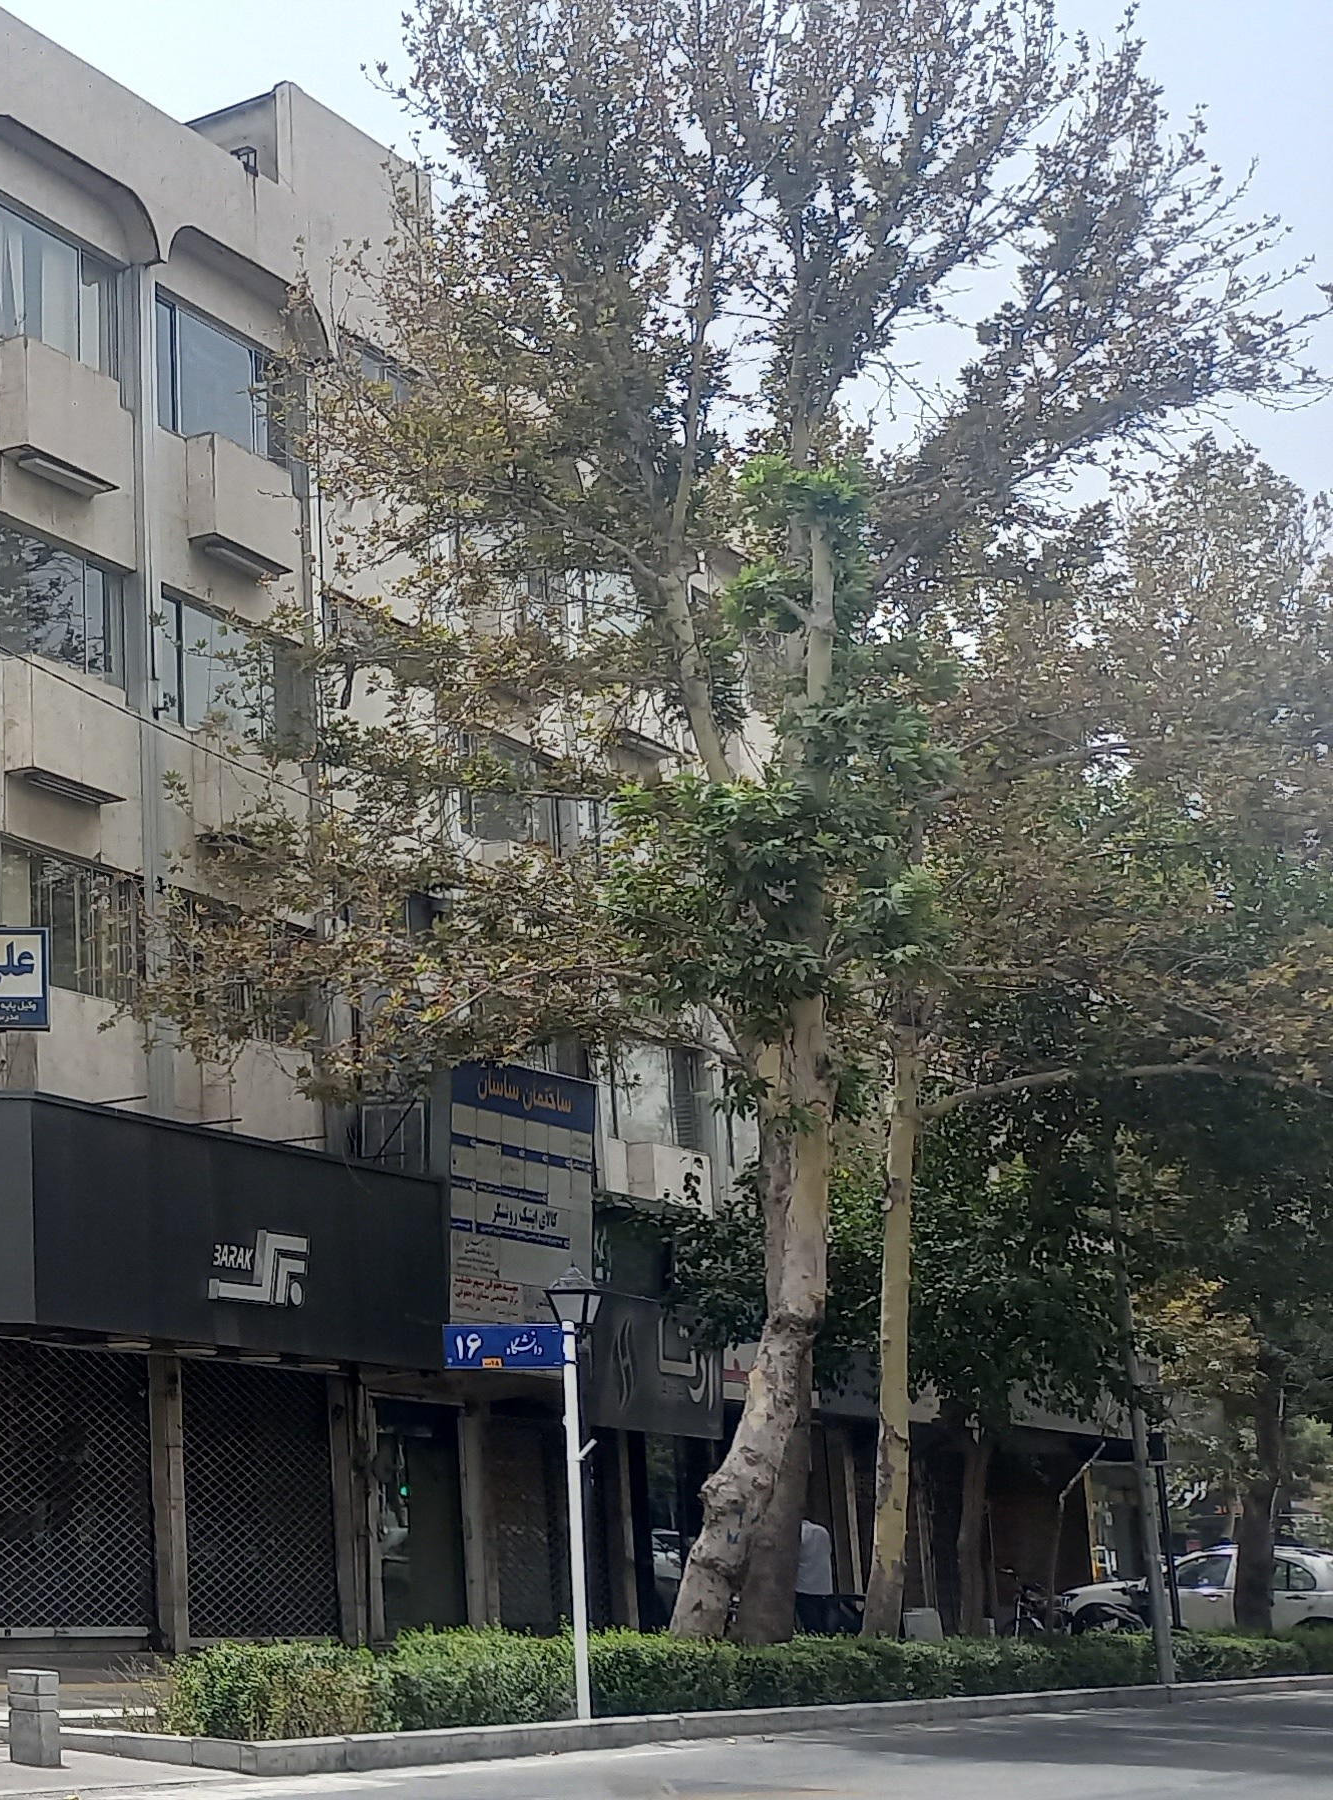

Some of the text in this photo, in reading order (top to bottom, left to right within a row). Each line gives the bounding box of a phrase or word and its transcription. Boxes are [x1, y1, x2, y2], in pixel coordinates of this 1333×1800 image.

[0, 1001, 17, 1011] پایه
[18, 1000, 38, 1011] وکیل
[477, 1069, 572, 1113] ساختمان ساسان
[212, 1244, 254, 1271] BARAK
[456, 1330, 544, 1360] دانشگاه ۱۶
